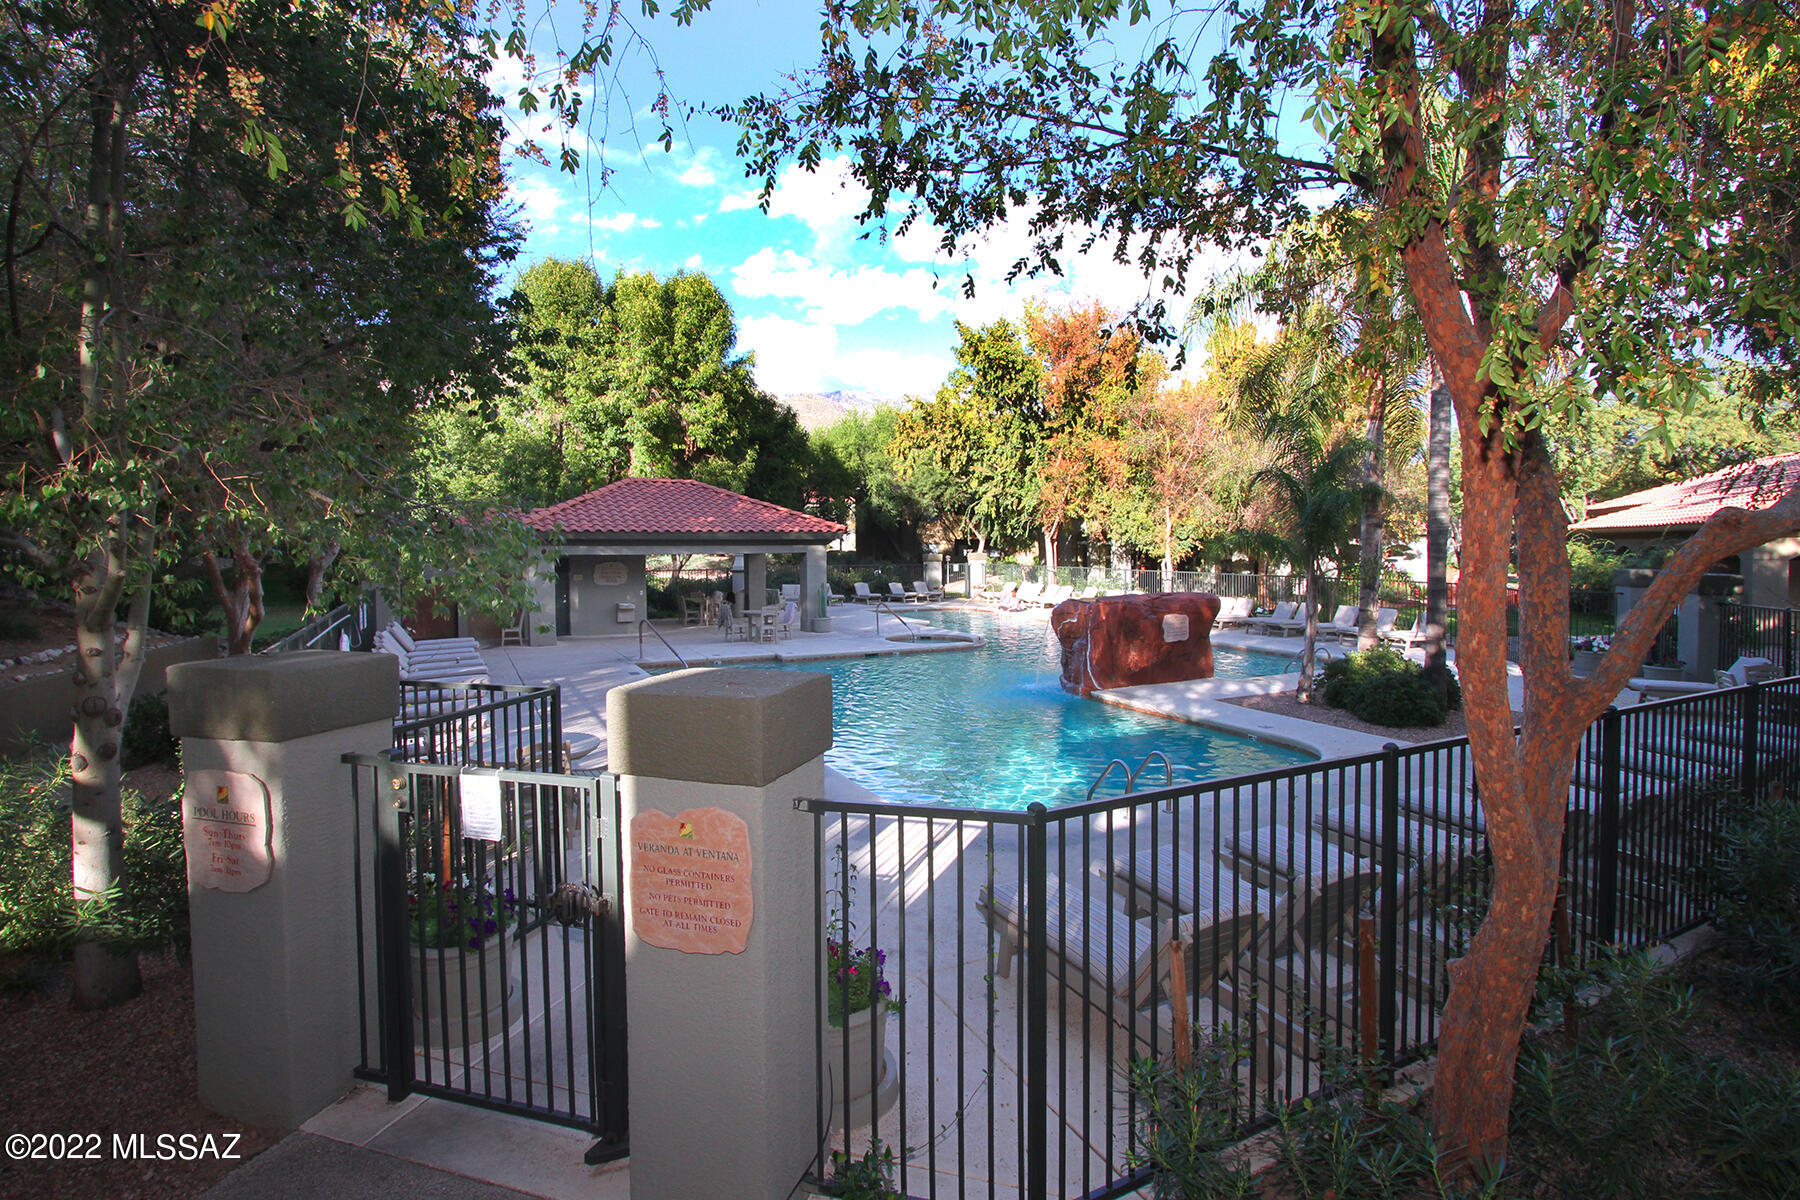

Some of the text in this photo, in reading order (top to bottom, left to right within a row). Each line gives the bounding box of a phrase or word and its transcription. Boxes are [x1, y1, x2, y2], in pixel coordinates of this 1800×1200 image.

[193, 807, 256, 823] POOL HOURS
[637, 842, 740, 862] VERANDA AT VENTANA
[643, 864, 735, 883] NO GLASS CONTAINERS
[665, 877, 713, 891] PERMITTED
[648, 892, 731, 910] NO PETS PERMITTED
[639, 907, 742, 928] GATE TO REMAIN CLOSED
[663, 919, 719, 934] AT ALL TIMES
